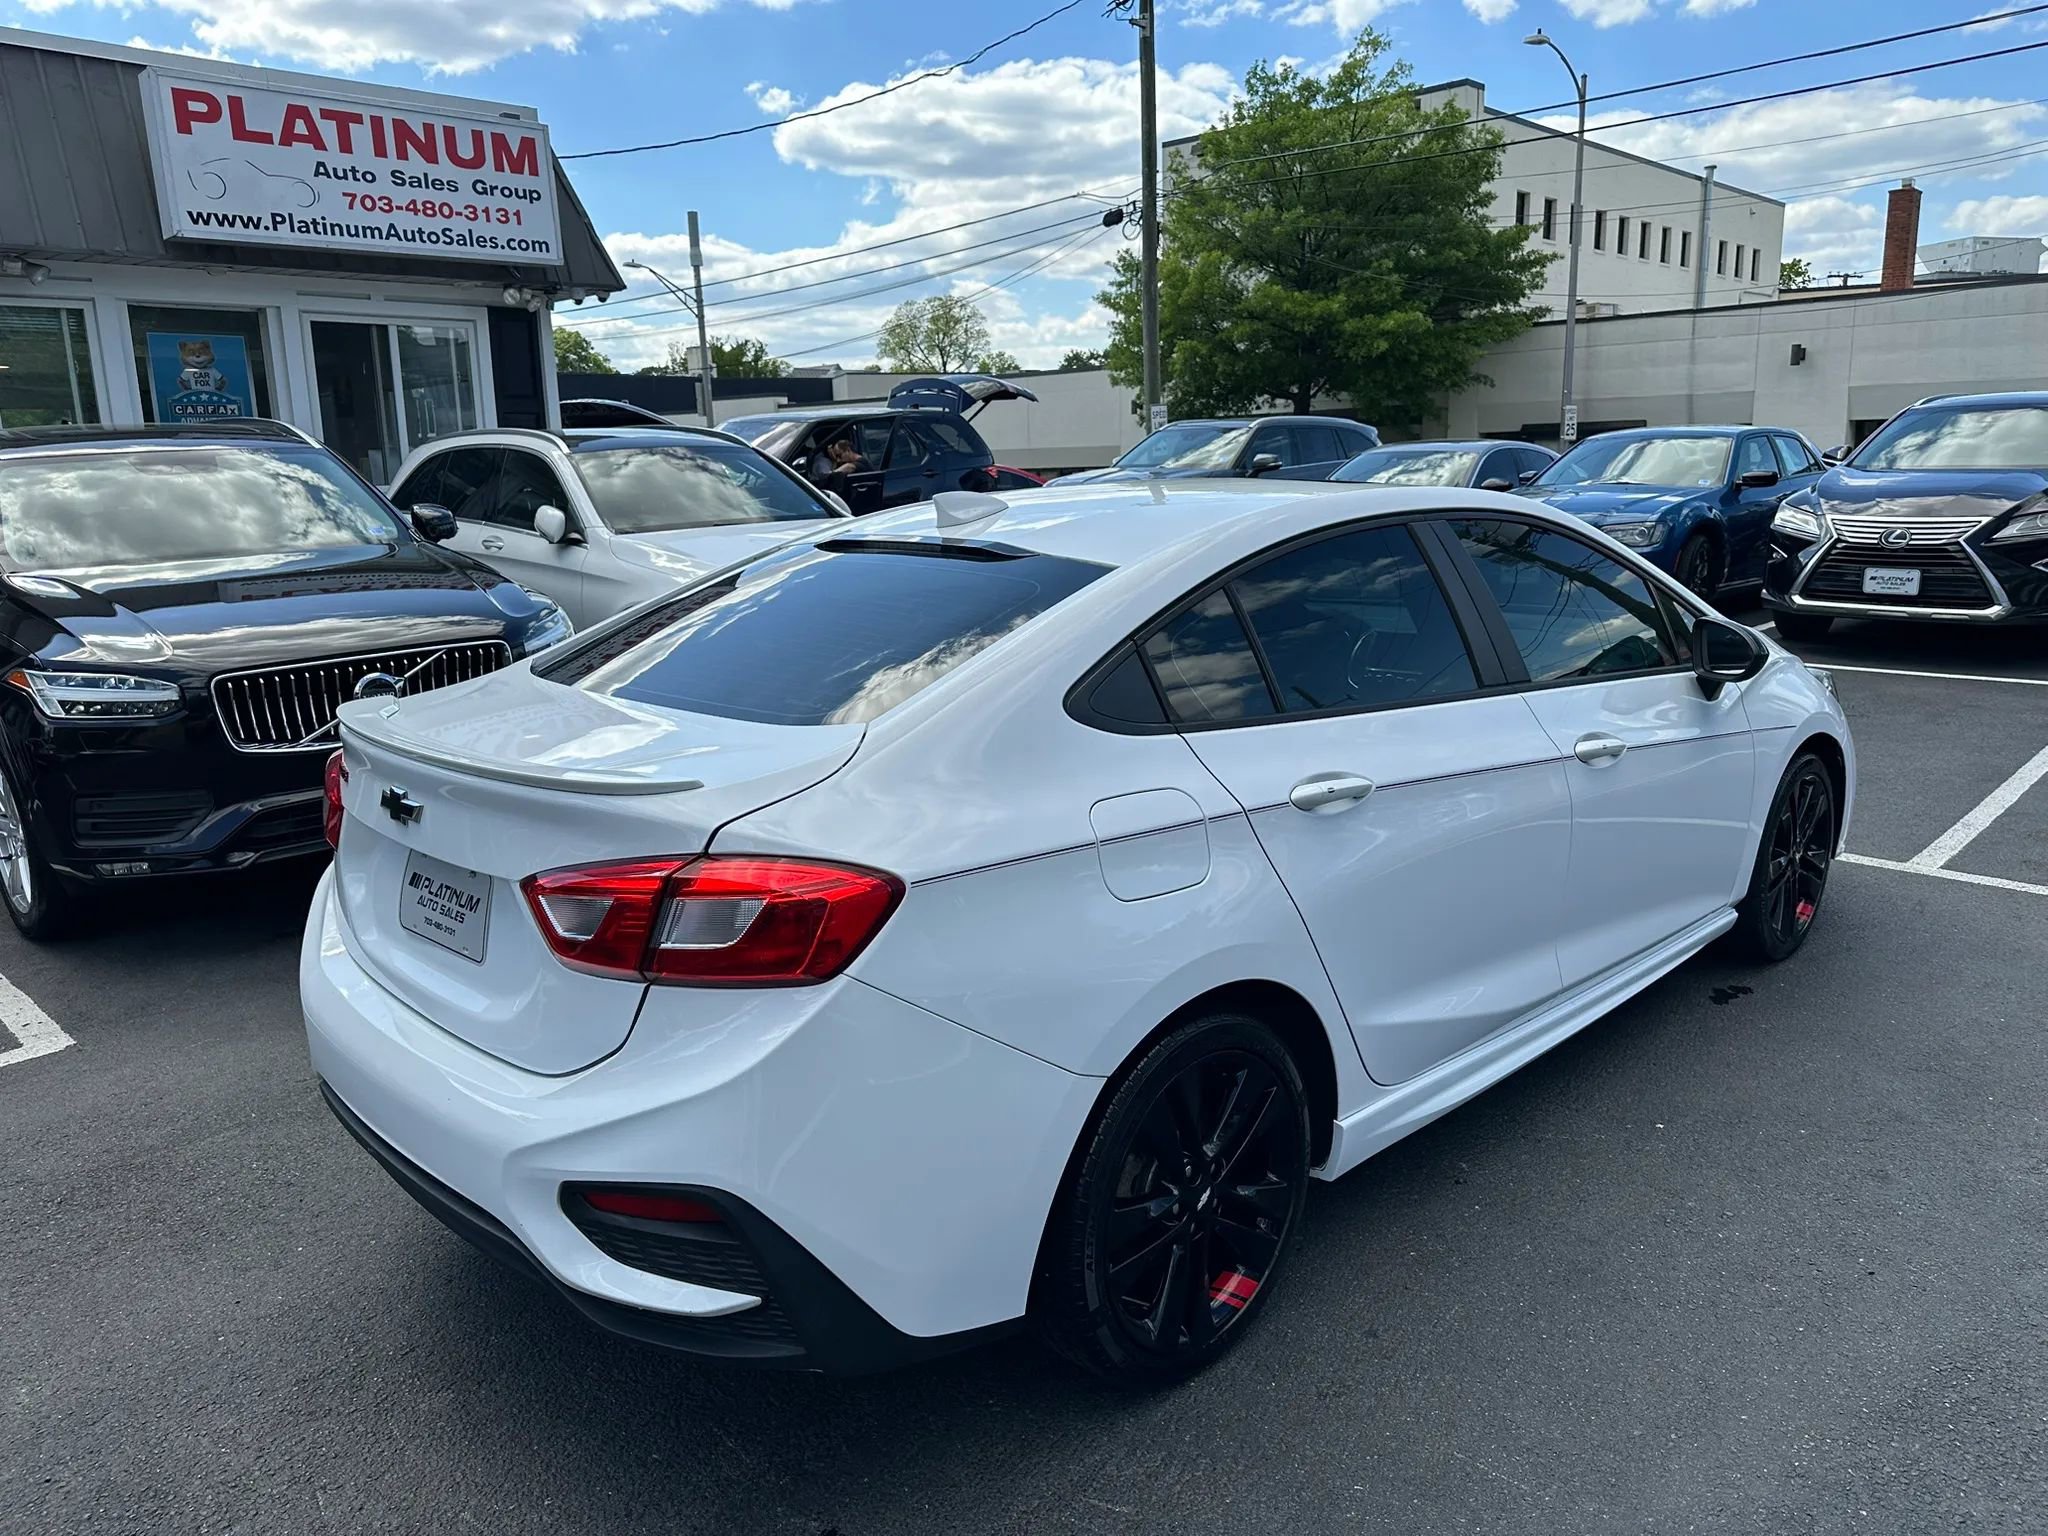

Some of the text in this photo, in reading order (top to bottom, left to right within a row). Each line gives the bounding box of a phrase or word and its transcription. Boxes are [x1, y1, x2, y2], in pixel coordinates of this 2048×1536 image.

[171, 87, 539, 177] PLATINUM
[313, 161, 542, 203] Auto Sales Group
[342, 192, 522, 226] 703-480-3131
[187, 210, 550, 254] www.PlatinumAutoSales.com
[175, 405, 237, 416] CARFAX
[1566, 423, 1576, 436] 25
[417, 895, 466, 924] AUTO SALES
[420, 876, 481, 914] PLATINUM
